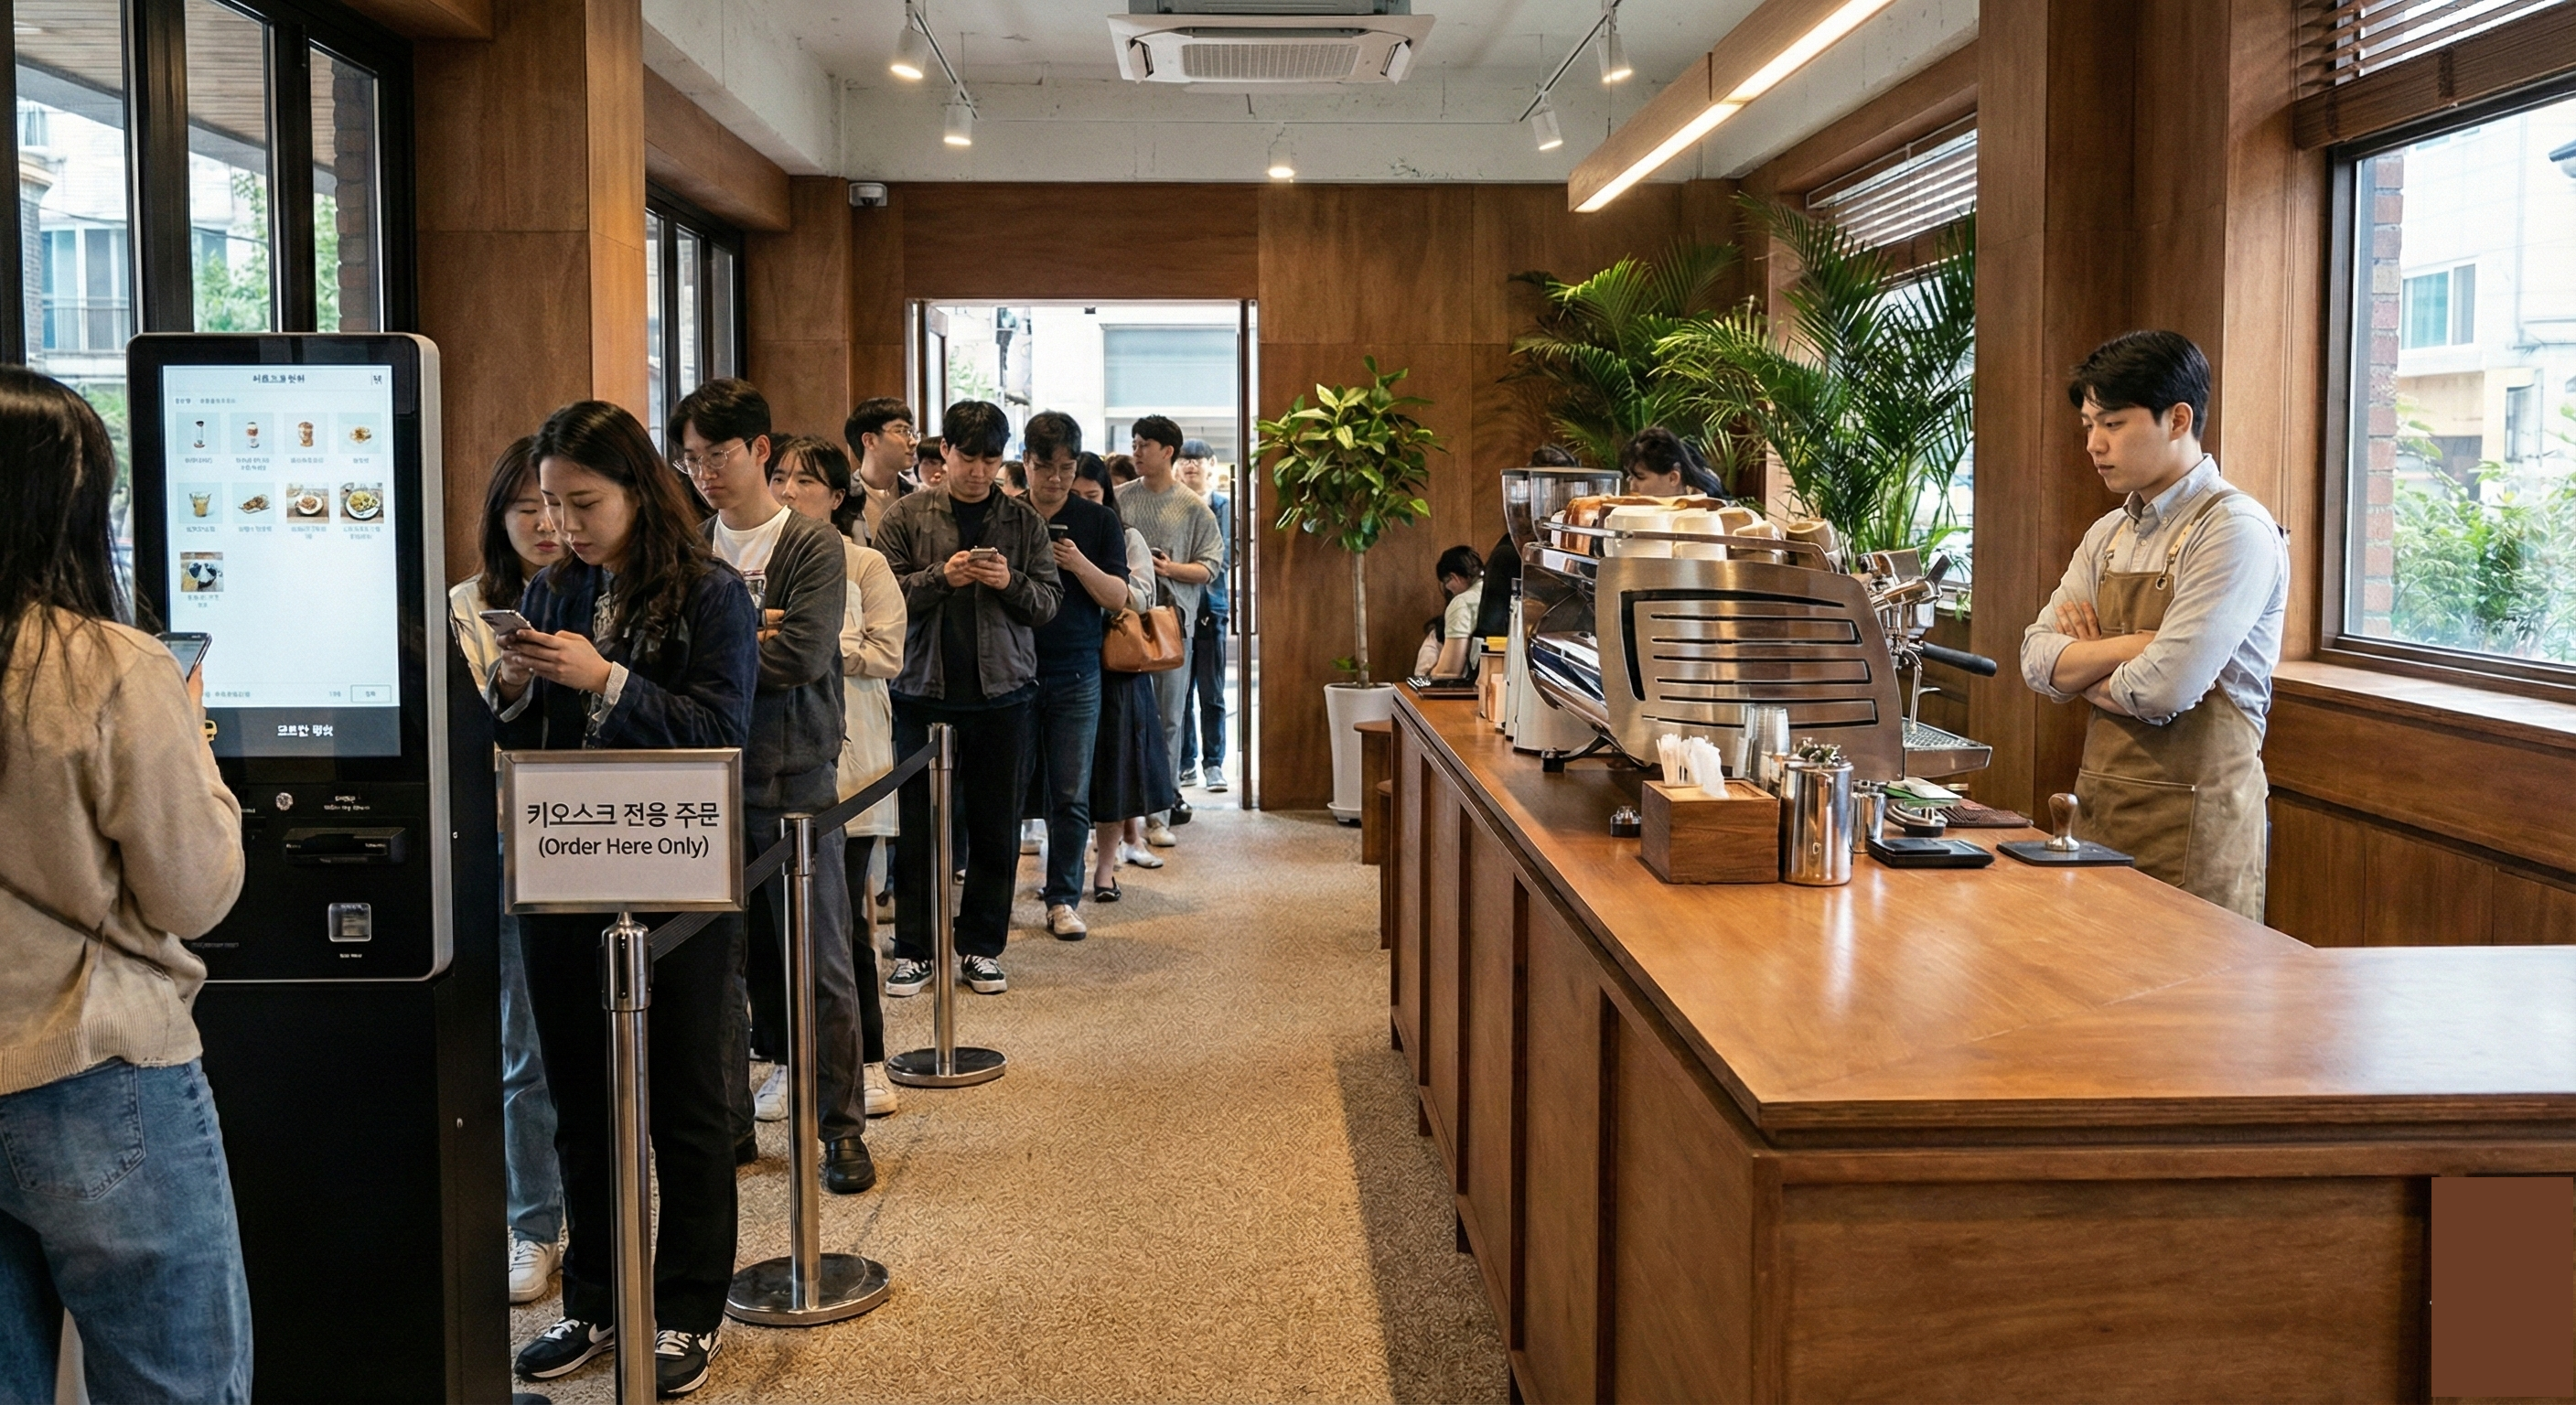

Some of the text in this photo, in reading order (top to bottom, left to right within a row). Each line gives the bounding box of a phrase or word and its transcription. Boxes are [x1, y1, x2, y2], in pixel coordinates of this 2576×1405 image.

[527, 801, 617, 829] 키오스크
[674, 802, 720, 829] 주문
[538, 835, 709, 859] (Order Here Only)
